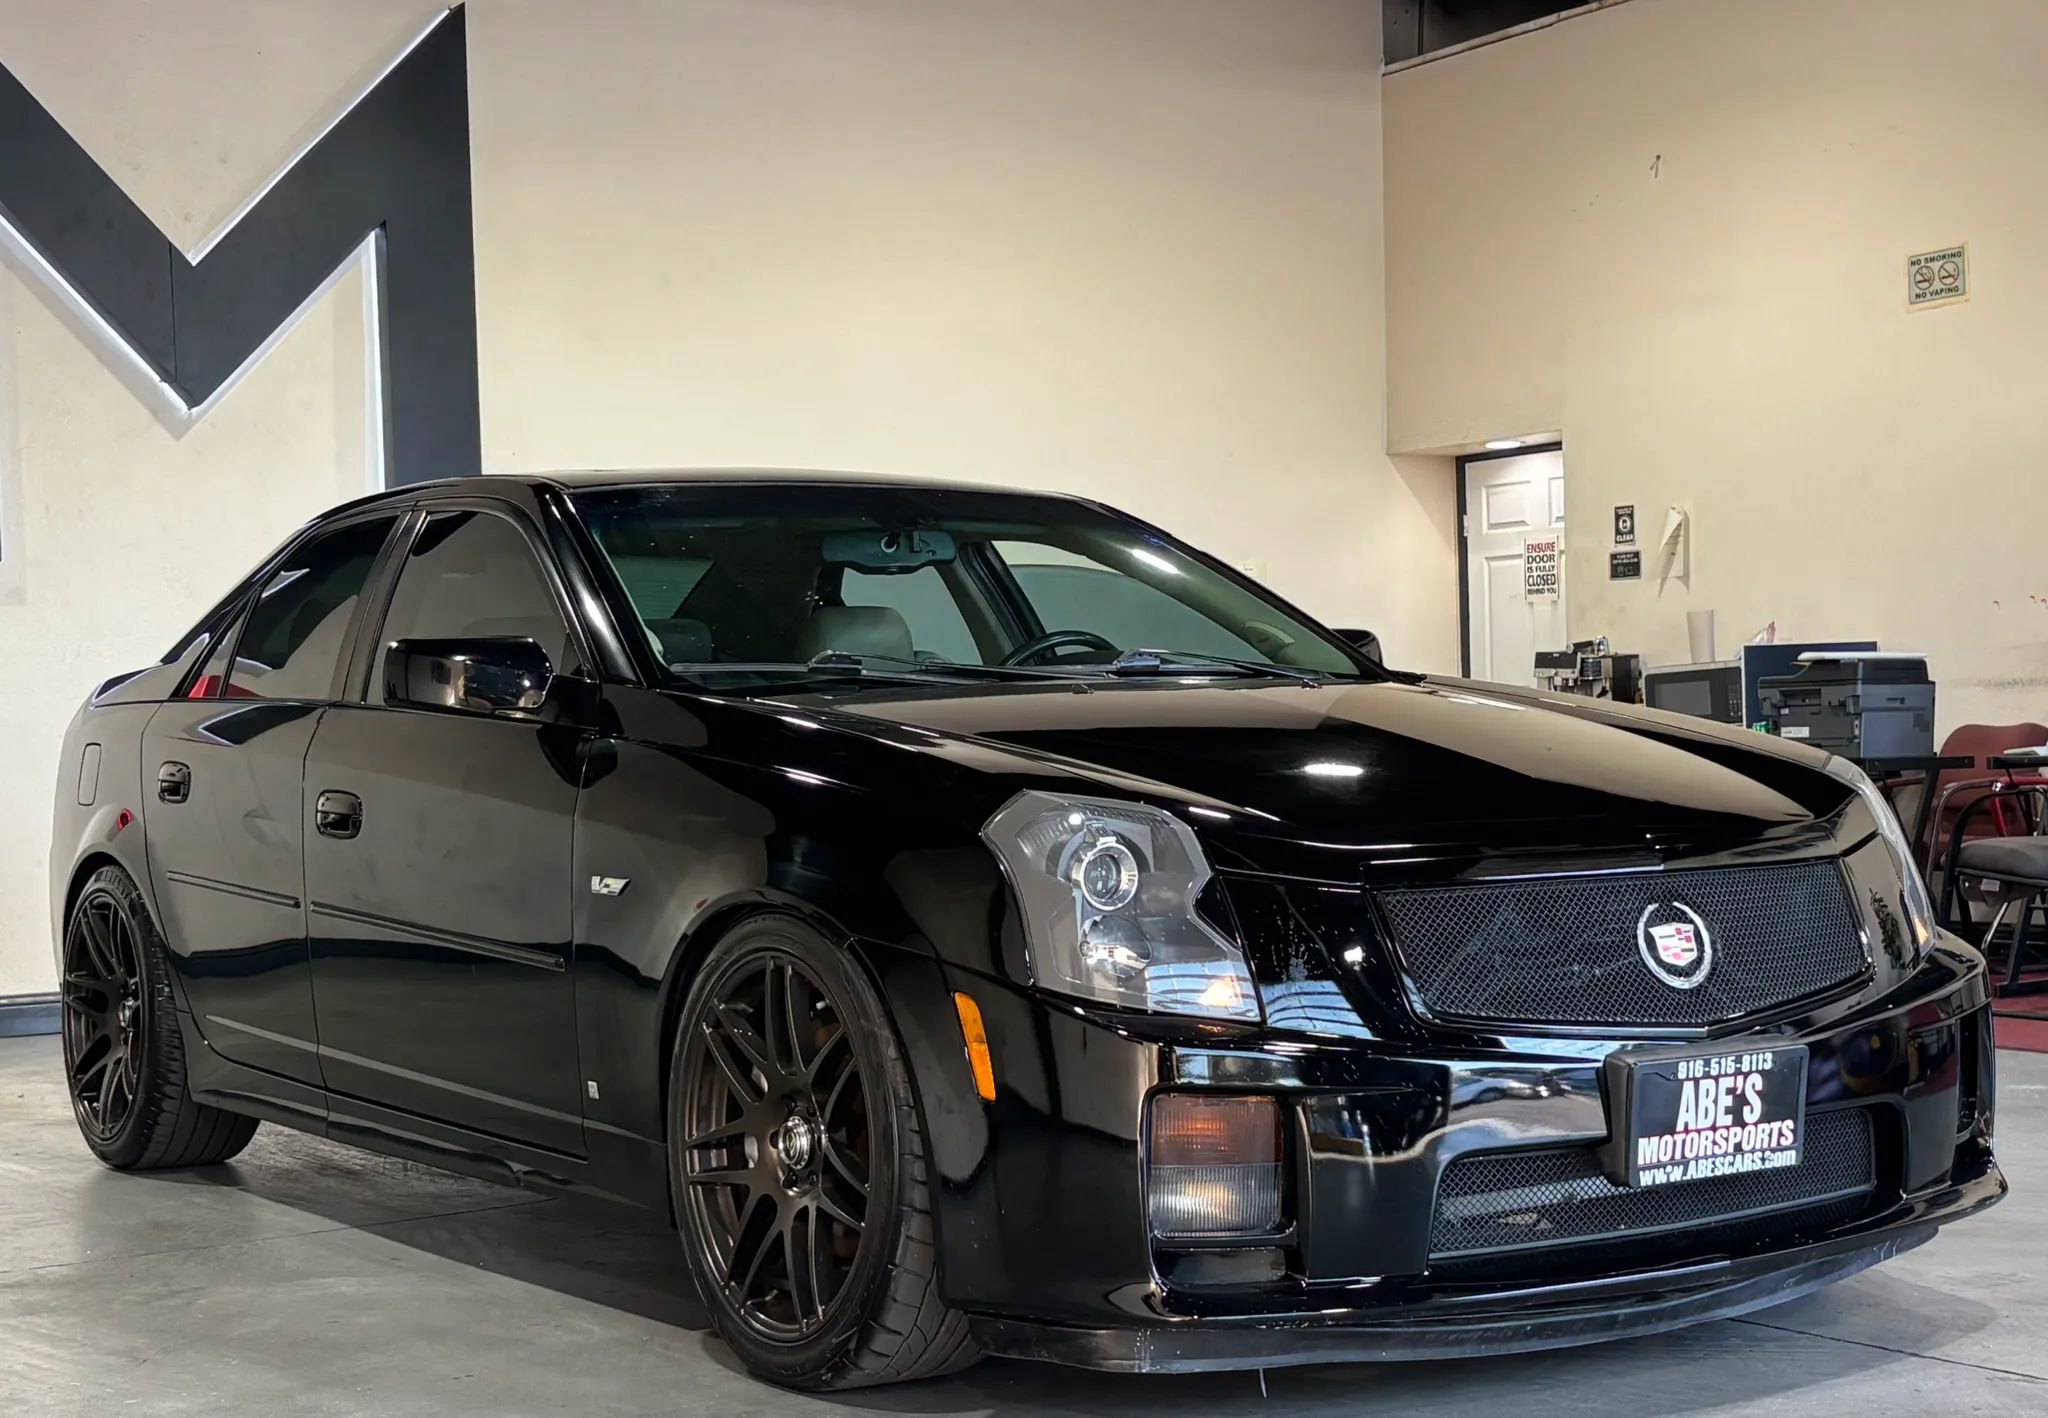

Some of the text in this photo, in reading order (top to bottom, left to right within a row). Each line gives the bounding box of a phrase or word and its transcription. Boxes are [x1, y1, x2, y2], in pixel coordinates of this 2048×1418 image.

[1911, 251, 1961, 267] NO SMOKING
[1915, 285, 1959, 300] NO VAPING
[1527, 542, 1555, 553] ENSURE
[1527, 554, 1555, 564] DOOR
[1535, 565, 1555, 573] FULLY
[1527, 573, 1556, 587] CLOSED
[1677, 1052, 1773, 1080] 916-515-8113
[1675, 1072, 1764, 1132] ABE'S
[1637, 1119, 1794, 1165] MOTORSPORTS
